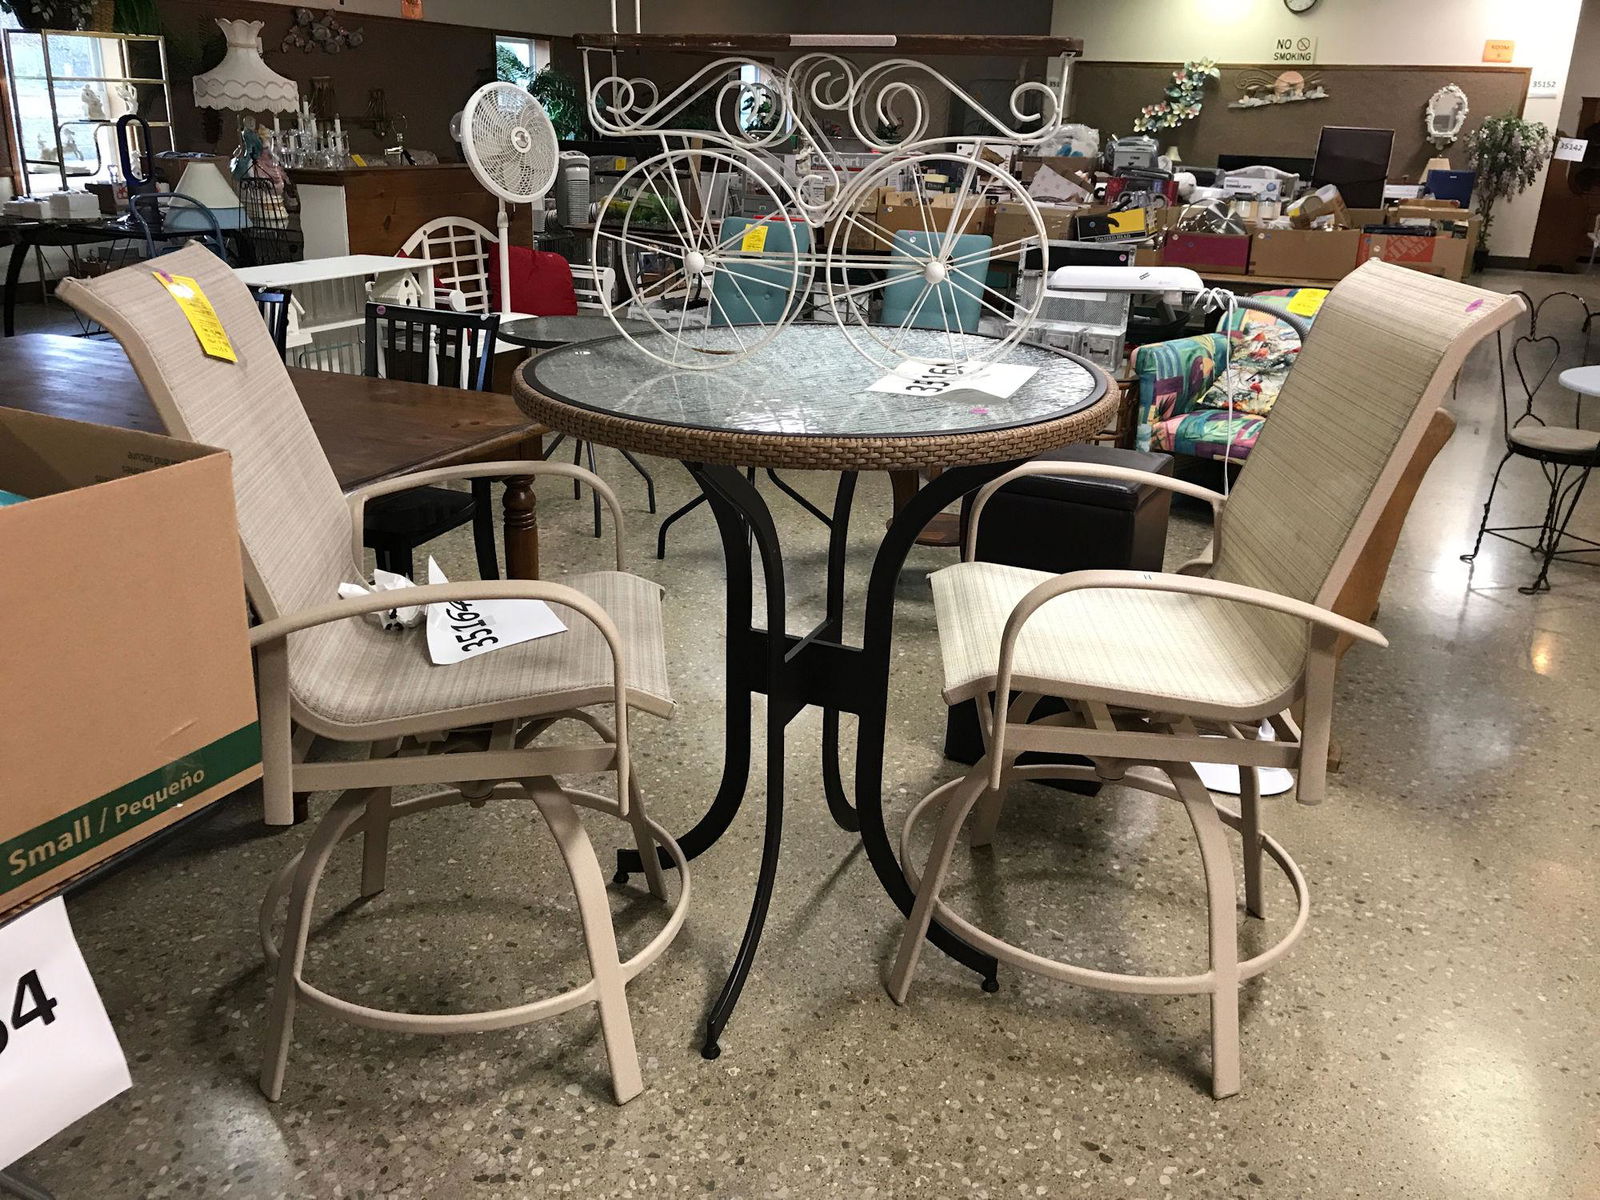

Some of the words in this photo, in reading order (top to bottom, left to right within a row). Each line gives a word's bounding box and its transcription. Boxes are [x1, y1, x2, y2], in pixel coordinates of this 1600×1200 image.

[1276, 39, 1292, 50] NO
[1273, 52, 1312, 61] SMOKING
[1532, 80, 1557, 88] 35152
[1559, 142, 1583, 152] 35142
[905, 363, 966, 393] 3516
[445, 600, 499, 652] 35164
[8, 815, 92, 876] Small
[99, 807, 108, 834] /
[114, 769, 205, 823] Pequeño
